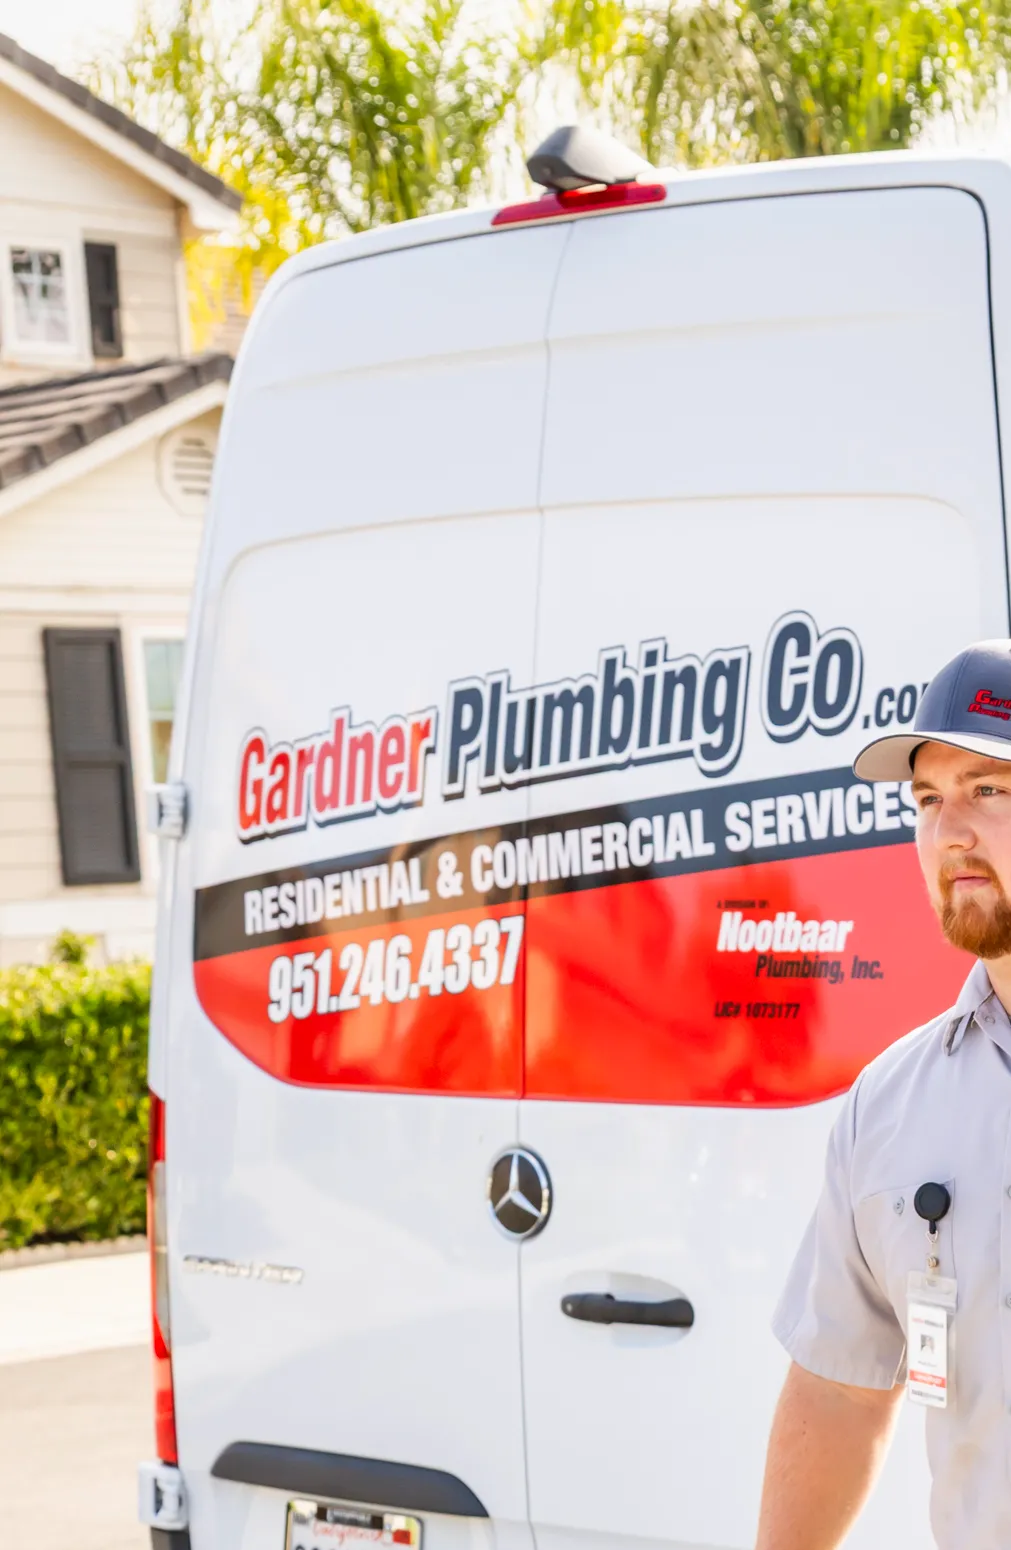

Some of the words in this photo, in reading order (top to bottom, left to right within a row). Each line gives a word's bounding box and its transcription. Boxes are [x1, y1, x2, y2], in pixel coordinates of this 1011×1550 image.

[238, 711, 434, 839] Gardner
[445, 642, 747, 772] Plumbing
[862, 683, 929, 729] .co
[244, 868, 429, 936] RESIDENTIAL
[436, 851, 463, 899] &
[471, 814, 715, 890] COMMERCIAL
[724, 779, 917, 854] SERVICES
[267, 915, 526, 1024] 951.246.4337
[716, 911, 855, 953] Nootbaar
[755, 955, 845, 985] Plumbing,
[851, 955, 884, 980] Inc.
